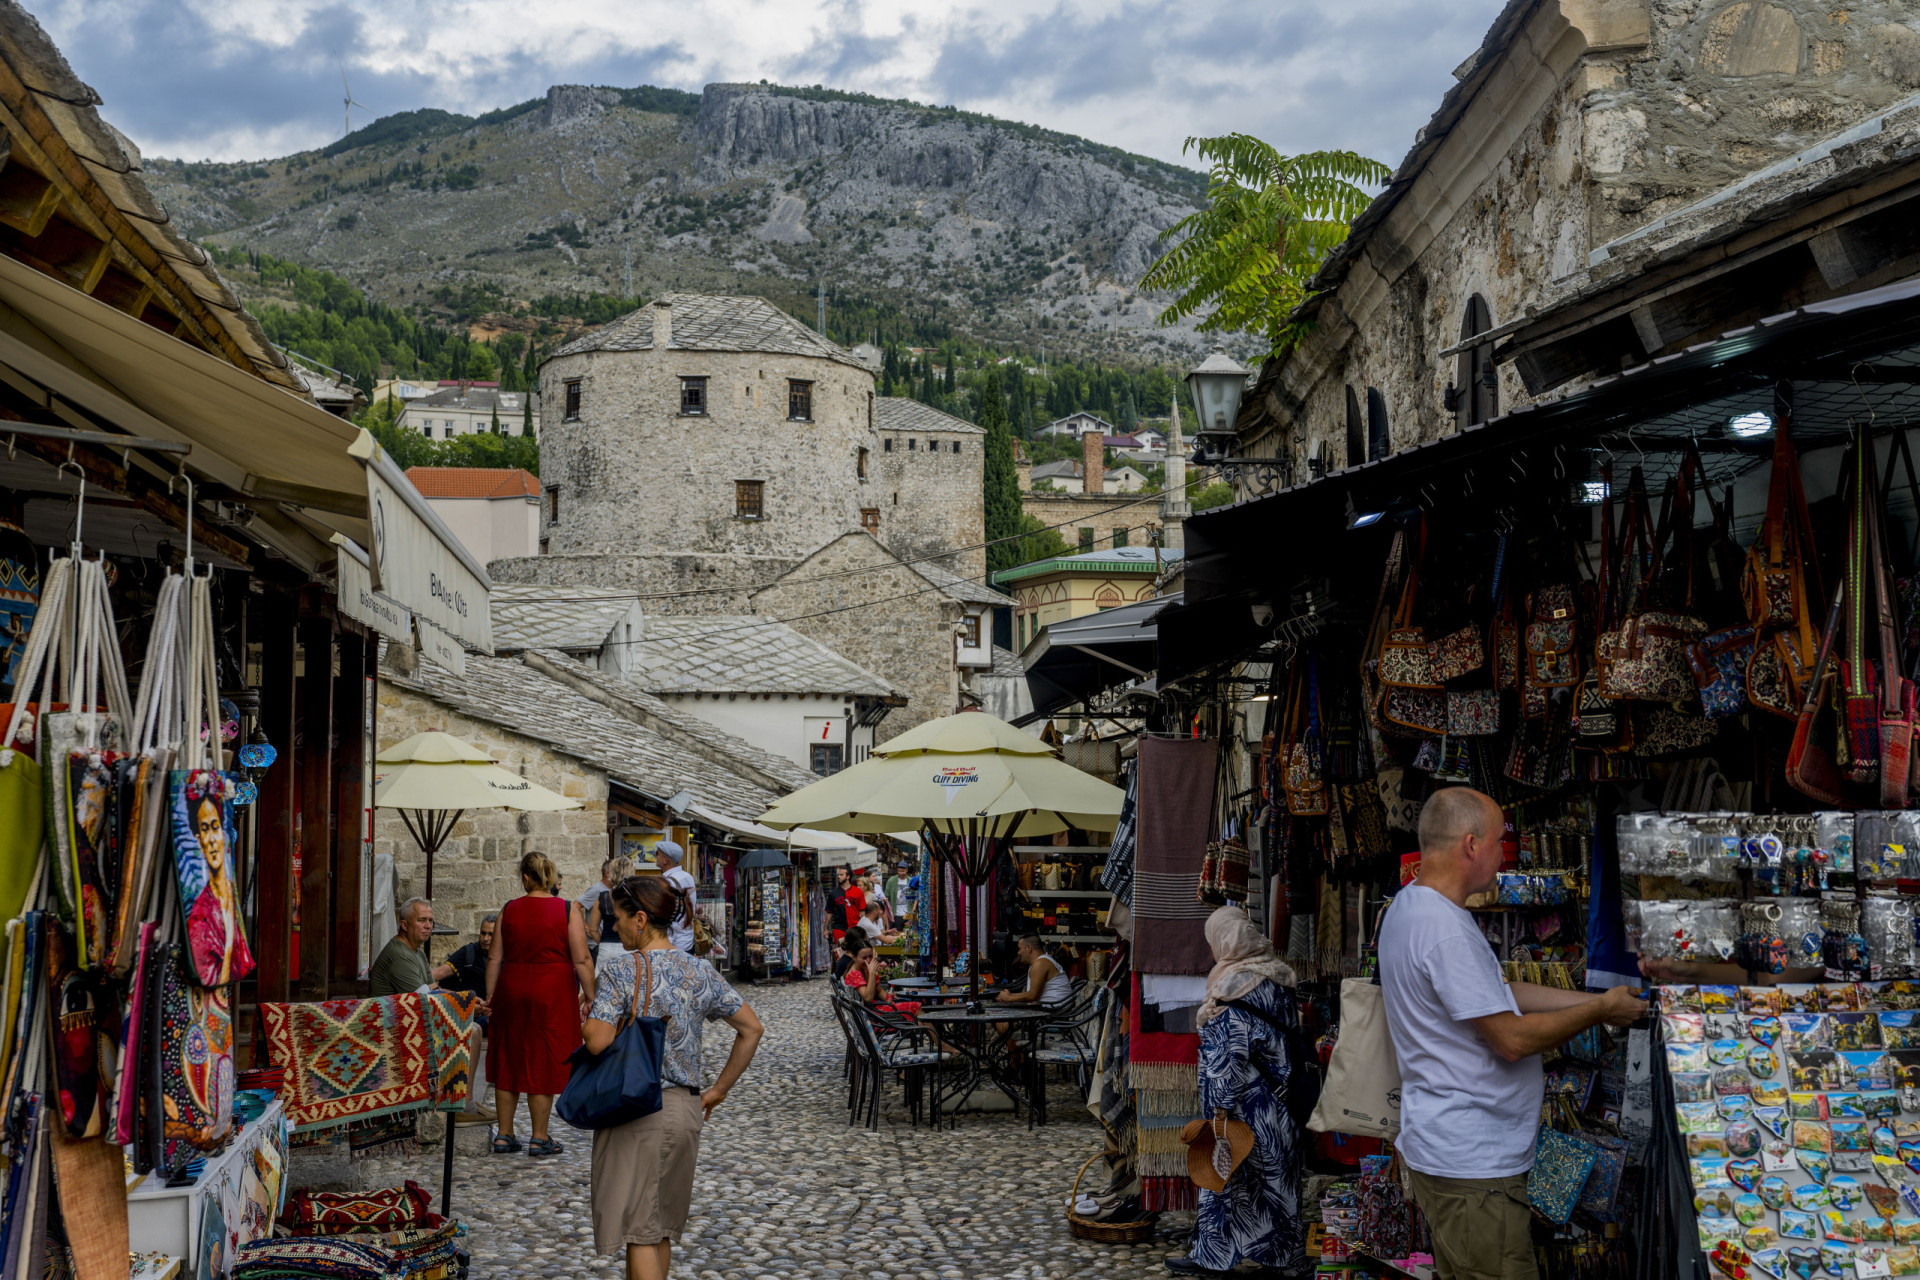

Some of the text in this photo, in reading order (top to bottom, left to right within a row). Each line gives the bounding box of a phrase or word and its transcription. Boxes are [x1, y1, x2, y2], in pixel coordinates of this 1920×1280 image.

[822, 721, 831, 740] i
[932, 774, 978, 783] CLIFF DIVING
